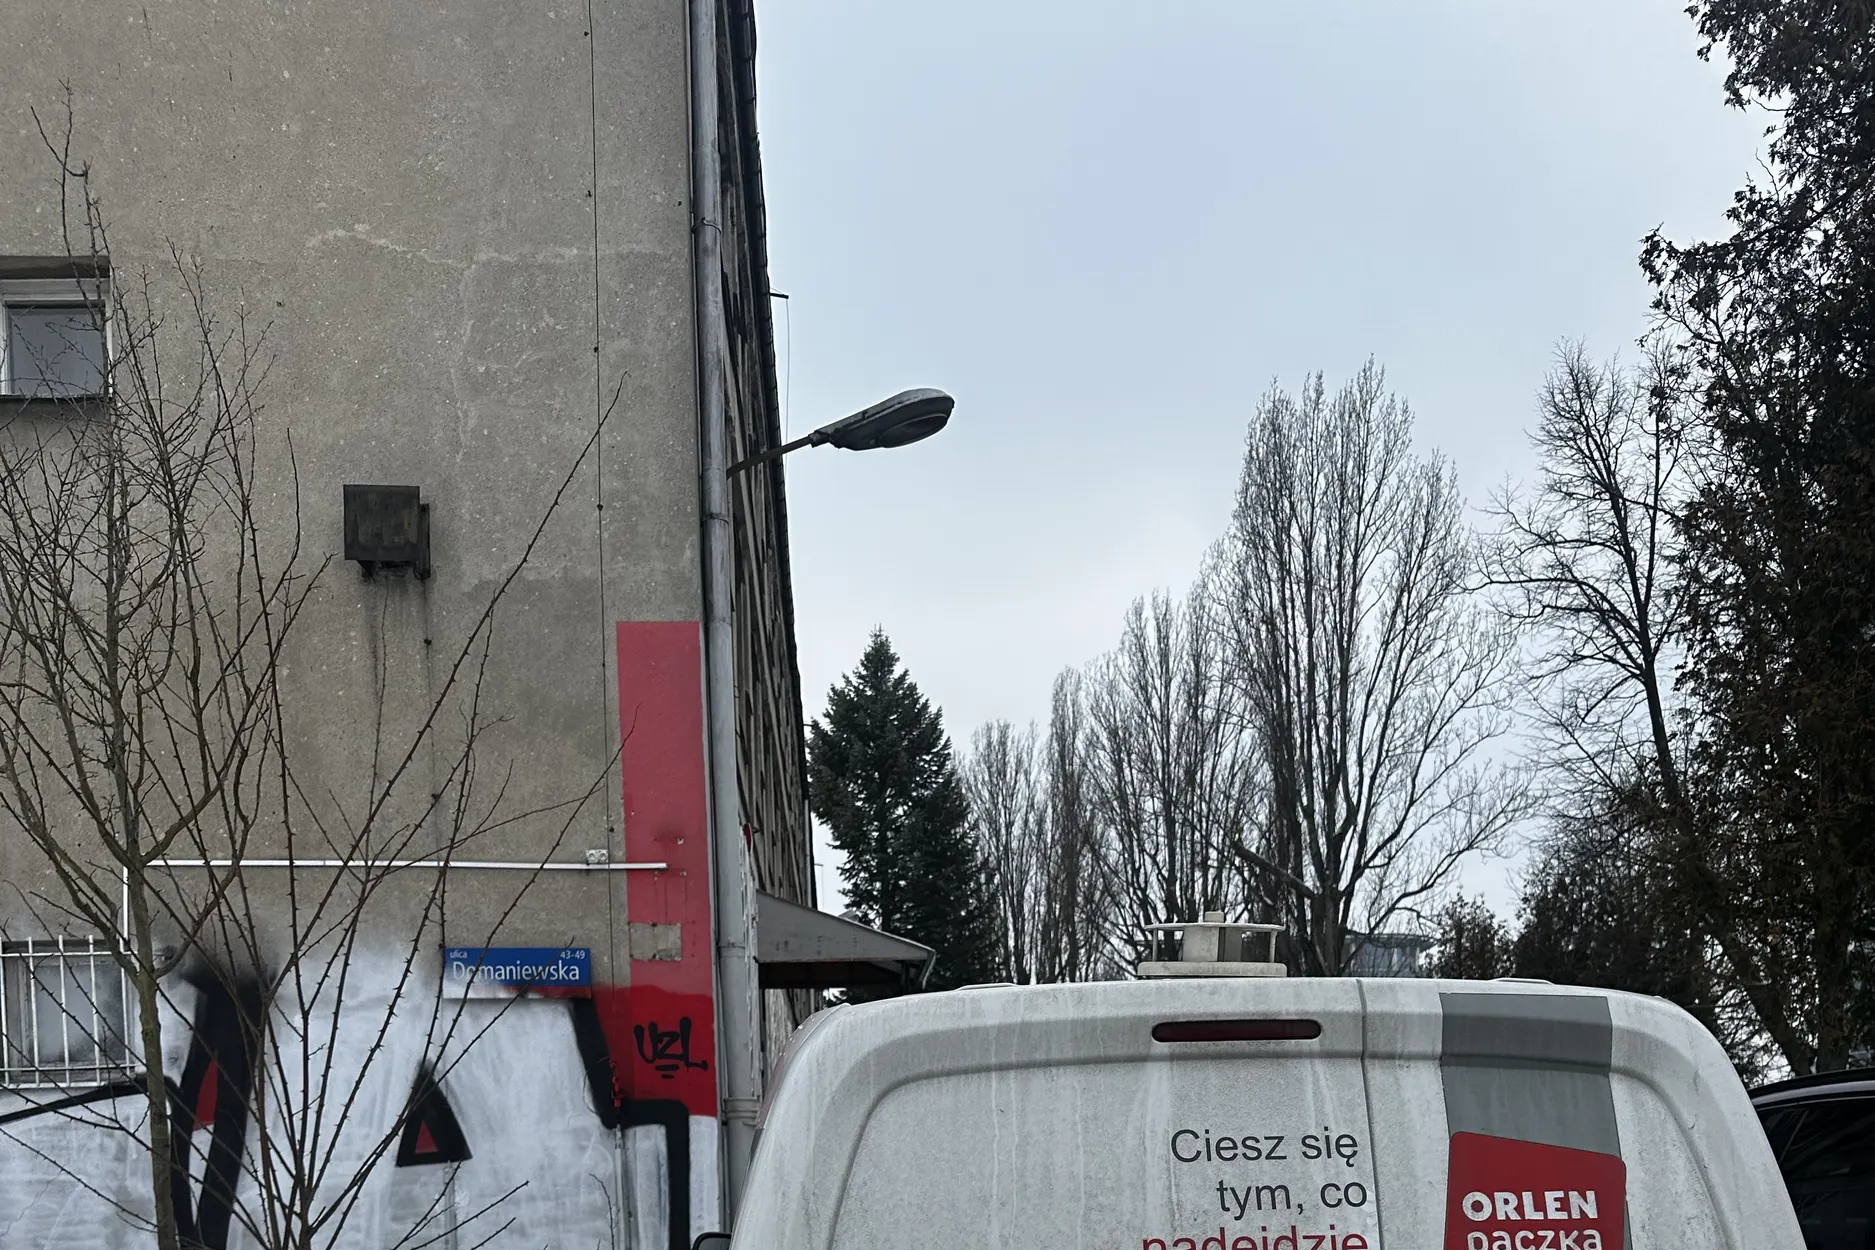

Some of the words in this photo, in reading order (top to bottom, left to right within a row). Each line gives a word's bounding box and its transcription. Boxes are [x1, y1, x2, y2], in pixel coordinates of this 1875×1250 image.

[450, 950, 468, 959] ulica
[560, 950, 586, 959] 43-49
[453, 960, 580, 980] Domaniewska
[1171, 1129, 1288, 1163] Ciesz
[1301, 1126, 1358, 1167] się
[1216, 1179, 1304, 1221] tym,
[1320, 1181, 1368, 1208] co
[1462, 1190, 1598, 1222] ORLEN
